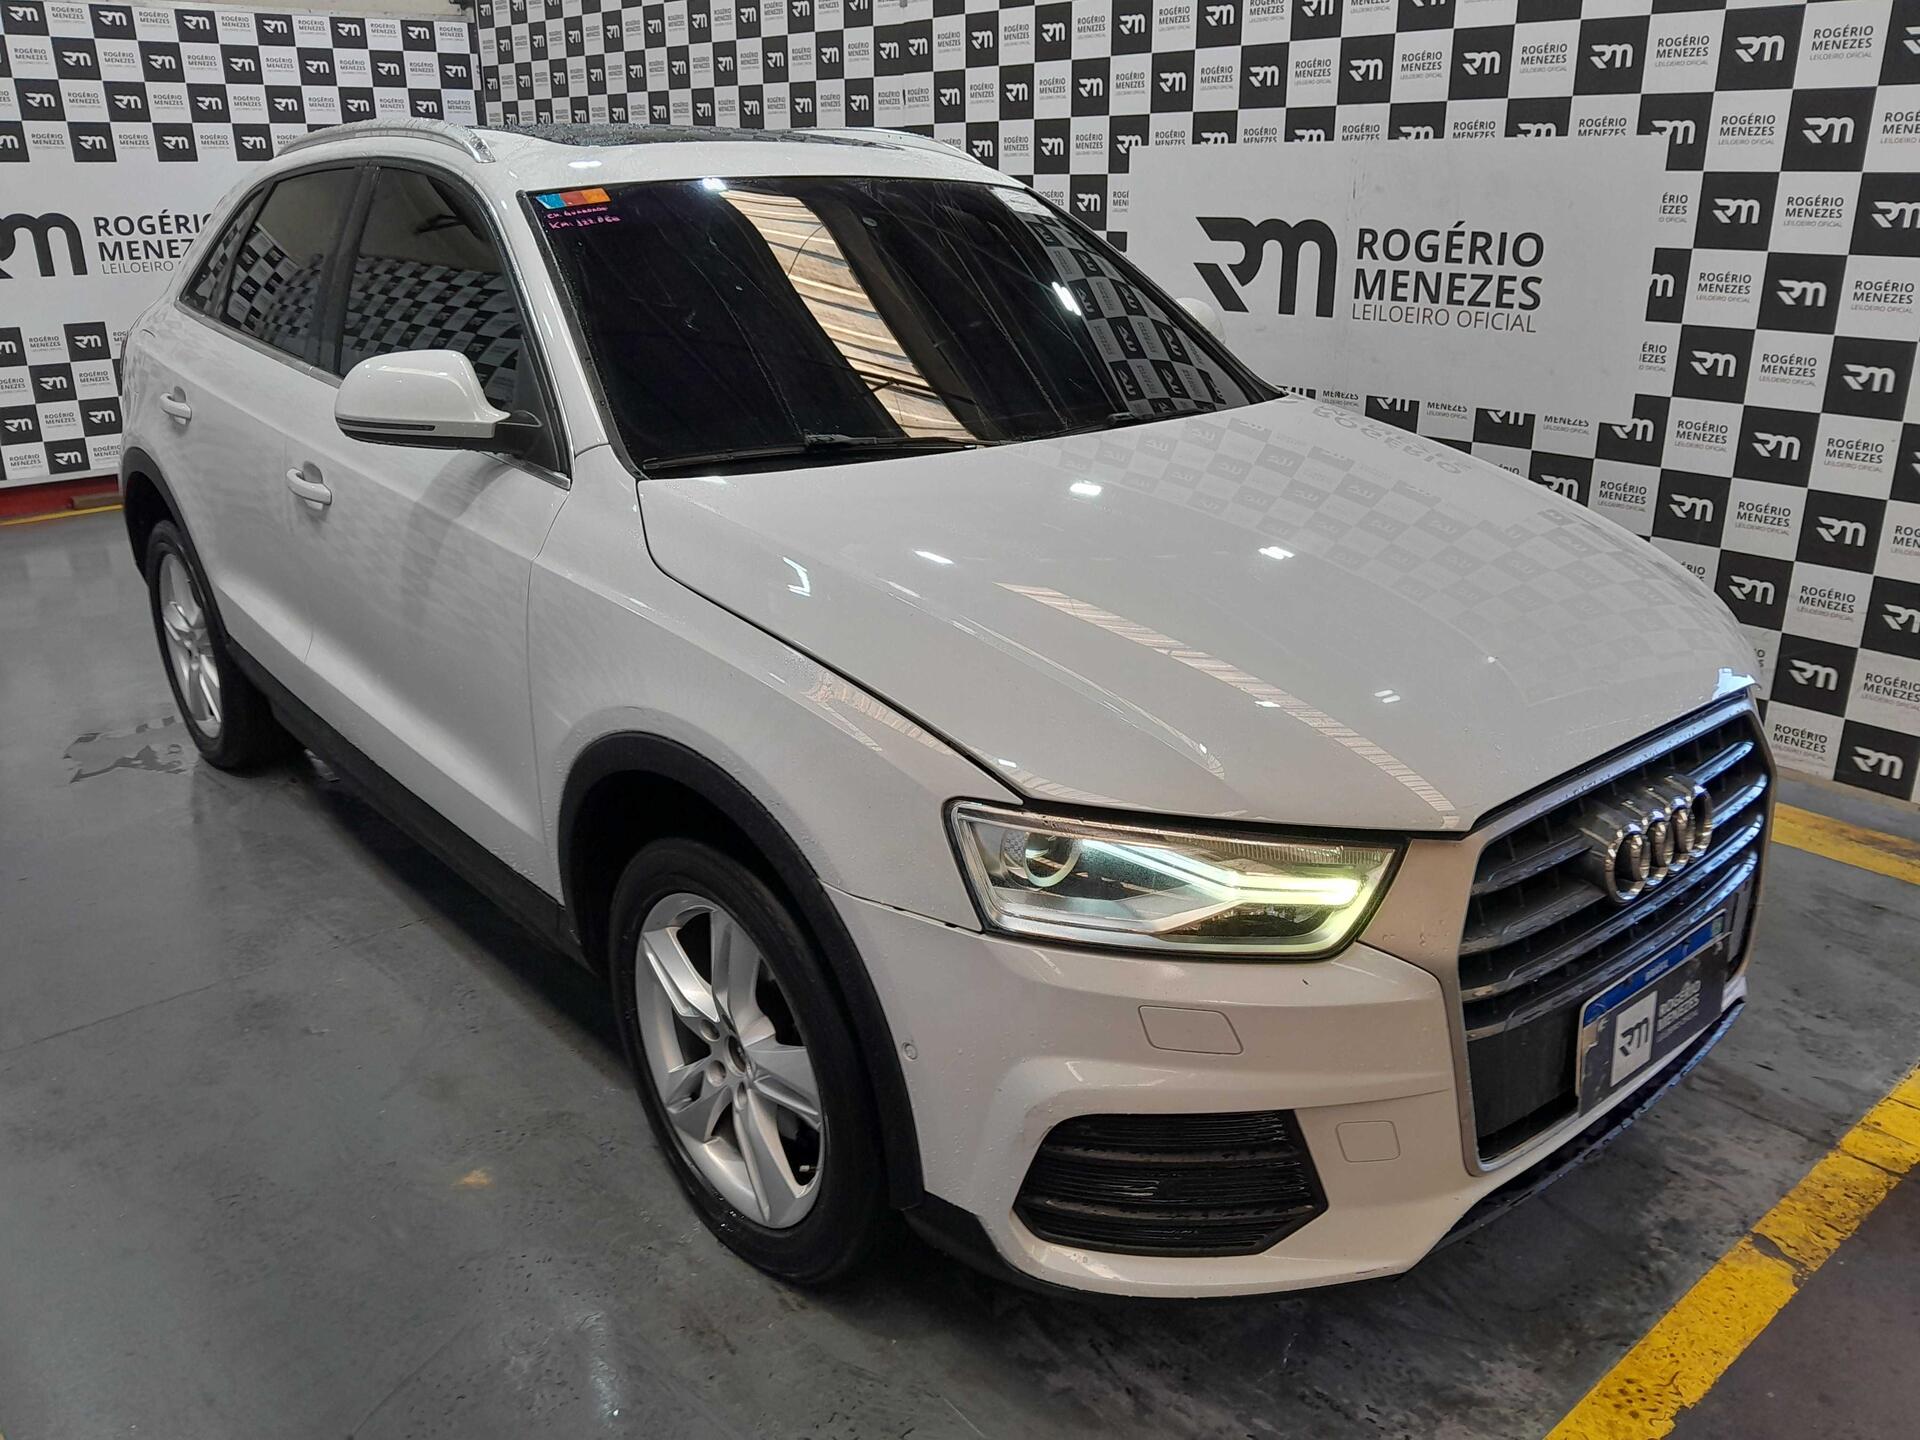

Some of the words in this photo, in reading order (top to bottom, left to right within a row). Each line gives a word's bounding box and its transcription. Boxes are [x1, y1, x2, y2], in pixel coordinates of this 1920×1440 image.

[1159, 5, 1191, 16] ROGÉRIO
[1249, 3, 1285, 15] MENEZES
[1078, 16, 1105, 25] ROGÉRIO
[1159, 14, 1191, 25] MENEZES
[1077, 24, 1105, 34] MENEZES
[1813, 24, 1874, 39] ROGÉRIO
[1004, 31, 1029, 40] MENEZES
[1658, 34, 1710, 47] ROGÉRIO
[1521, 42, 1568, 54] ROGÉRIO
[1811, 38, 1872, 51] MENEZES
[1402, 50, 1443, 63] ROGÉRIO
[1656, 47, 1709, 58] MENEZES
[1296, 58, 1332, 70] ROGÉRIO
[1520, 54, 1567, 65] MENEZES
[1201, 65, 1233, 75] ROGÉRIO
[1295, 67, 1331, 79] MENEZES
[1401, 61, 1442, 73] MENEZES
[1116, 71, 1145, 81] ROGÉRIO
[1200, 74, 1233, 84] MENEZES
[1039, 85, 1065, 94] MENEZES
[1115, 80, 1145, 90] MENEZES
[1579, 116, 1627, 128] ROGÉRIO
[1721, 113, 1776, 125] ROGÉRIO
[1884, 110, 1920, 123] ROGÉ
[1342, 123, 1380, 134] ROGÉRIO
[1454, 120, 1496, 132] ROGÉRIO
[1720, 125, 1775, 137] MENEZES
[1882, 123, 1920, 135] MENE
[1155, 130, 1186, 140] ROGÉRIO
[1244, 127, 1278, 138] ROGÉRIO
[1004, 143, 1029, 151] MENEZES
[1076, 140, 1103, 150] MENEZES
[1662, 192, 1688, 204] ÉRIO
[1787, 195, 1844, 207] ROGÉRIO
[1785, 207, 1843, 218] MENEZES
[1357, 221, 1544, 267] ROGÉRIO
[102, 261, 173, 274] LEILOEIRO
[1699, 271, 1752, 284] ROGÉRIO
[1354, 269, 1543, 310] MENEZES
[1697, 284, 1751, 295] MENEZES
[1855, 280, 1914, 293] ROGÉRIO
[1852, 292, 1913, 305] MENEZES
[1352, 303, 1449, 326] LEILOEIRO
[1457, 309, 1536, 332] OFICIAL
[1642, 342, 1667, 354] ÉRIO
[1762, 353, 1817, 367] ROGÉRIO
[1760, 365, 1816, 377] MENEZES
[1677, 420, 1728, 434] ROGÉRIO
[1676, 431, 1728, 444] MENEZES
[1827, 437, 1885, 452] ROGÉRIO
[1825, 448, 1883, 464] MENEZES
[1600, 480, 1647, 495] ROGÉRIO
[1598, 490, 1646, 504] MENEZES
[1738, 501, 1791, 516] ROGÉRIO
[1736, 512, 1790, 527] MENEZES
[1801, 586, 1856, 603] ROGÉRIO
[1798, 597, 1855, 614] MENEZES
[1775, 724, 1828, 743] ROGÉRIO
[1773, 733, 1826, 754] MENEZES
